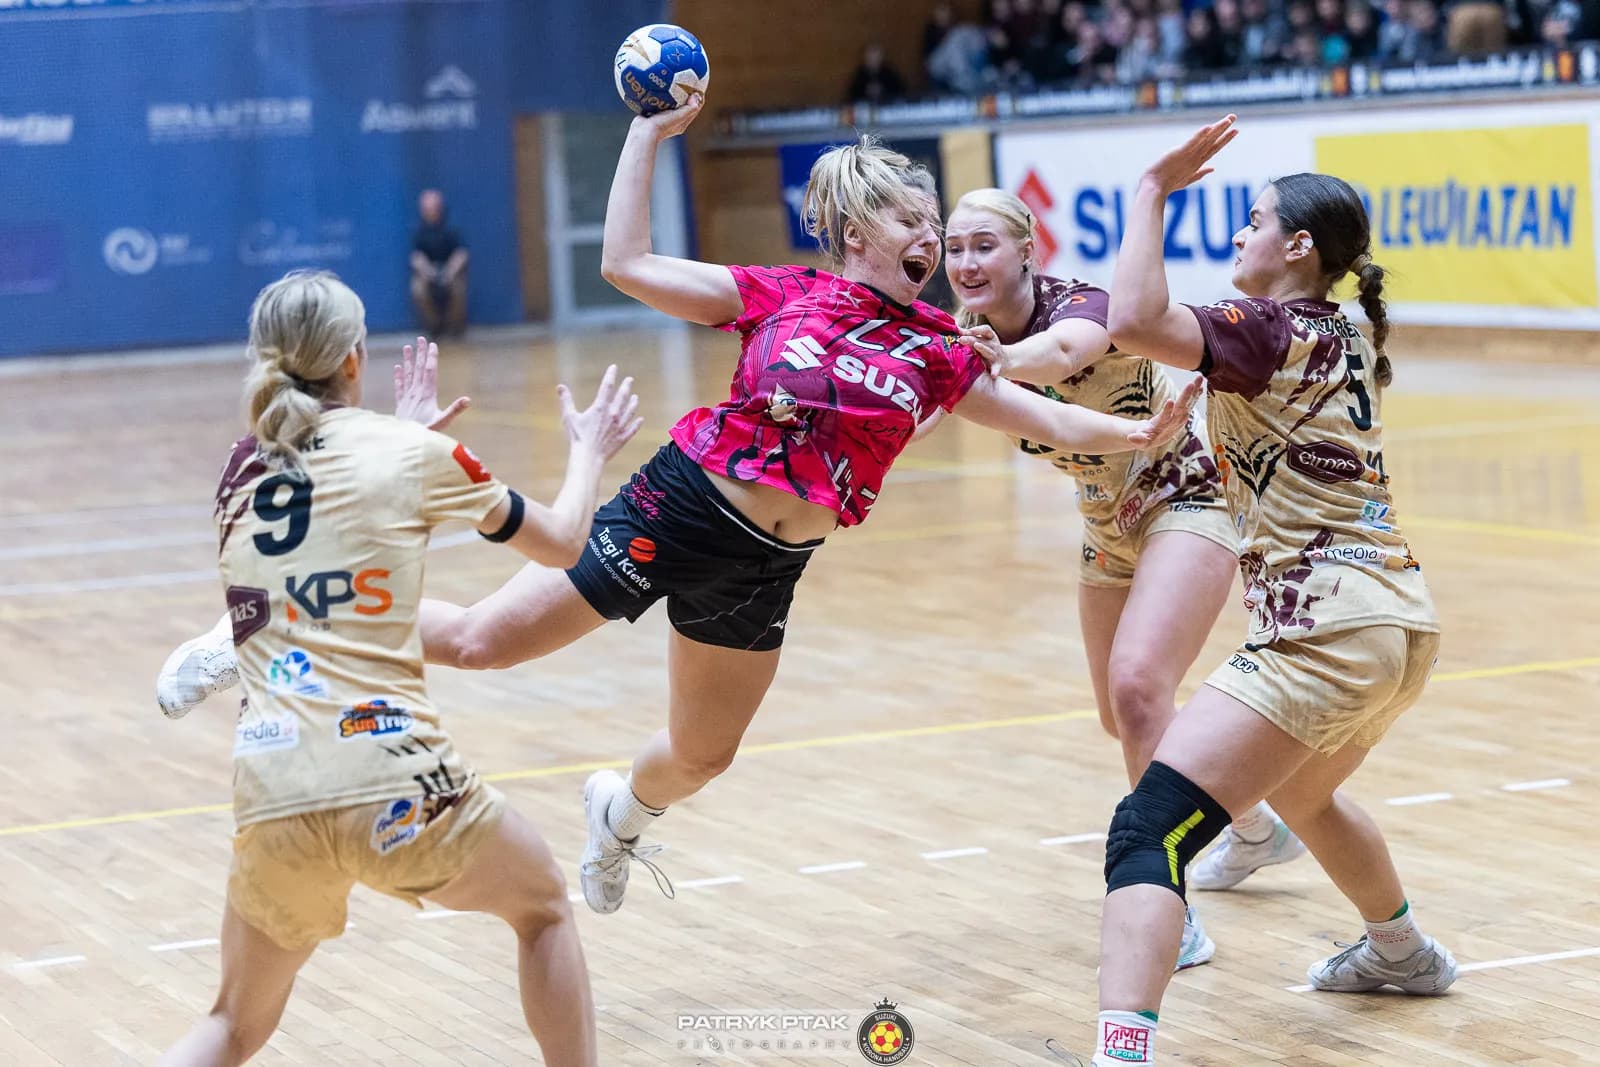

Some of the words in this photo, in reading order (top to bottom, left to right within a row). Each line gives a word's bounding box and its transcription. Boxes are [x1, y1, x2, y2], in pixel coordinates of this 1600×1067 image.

[1381, 176, 1574, 246] LEWIATAN
[1345, 353, 1372, 431] 5
[253, 472, 314, 556] 9
[598, 527, 623, 557] Targi
[285, 569, 394, 622] KPS
